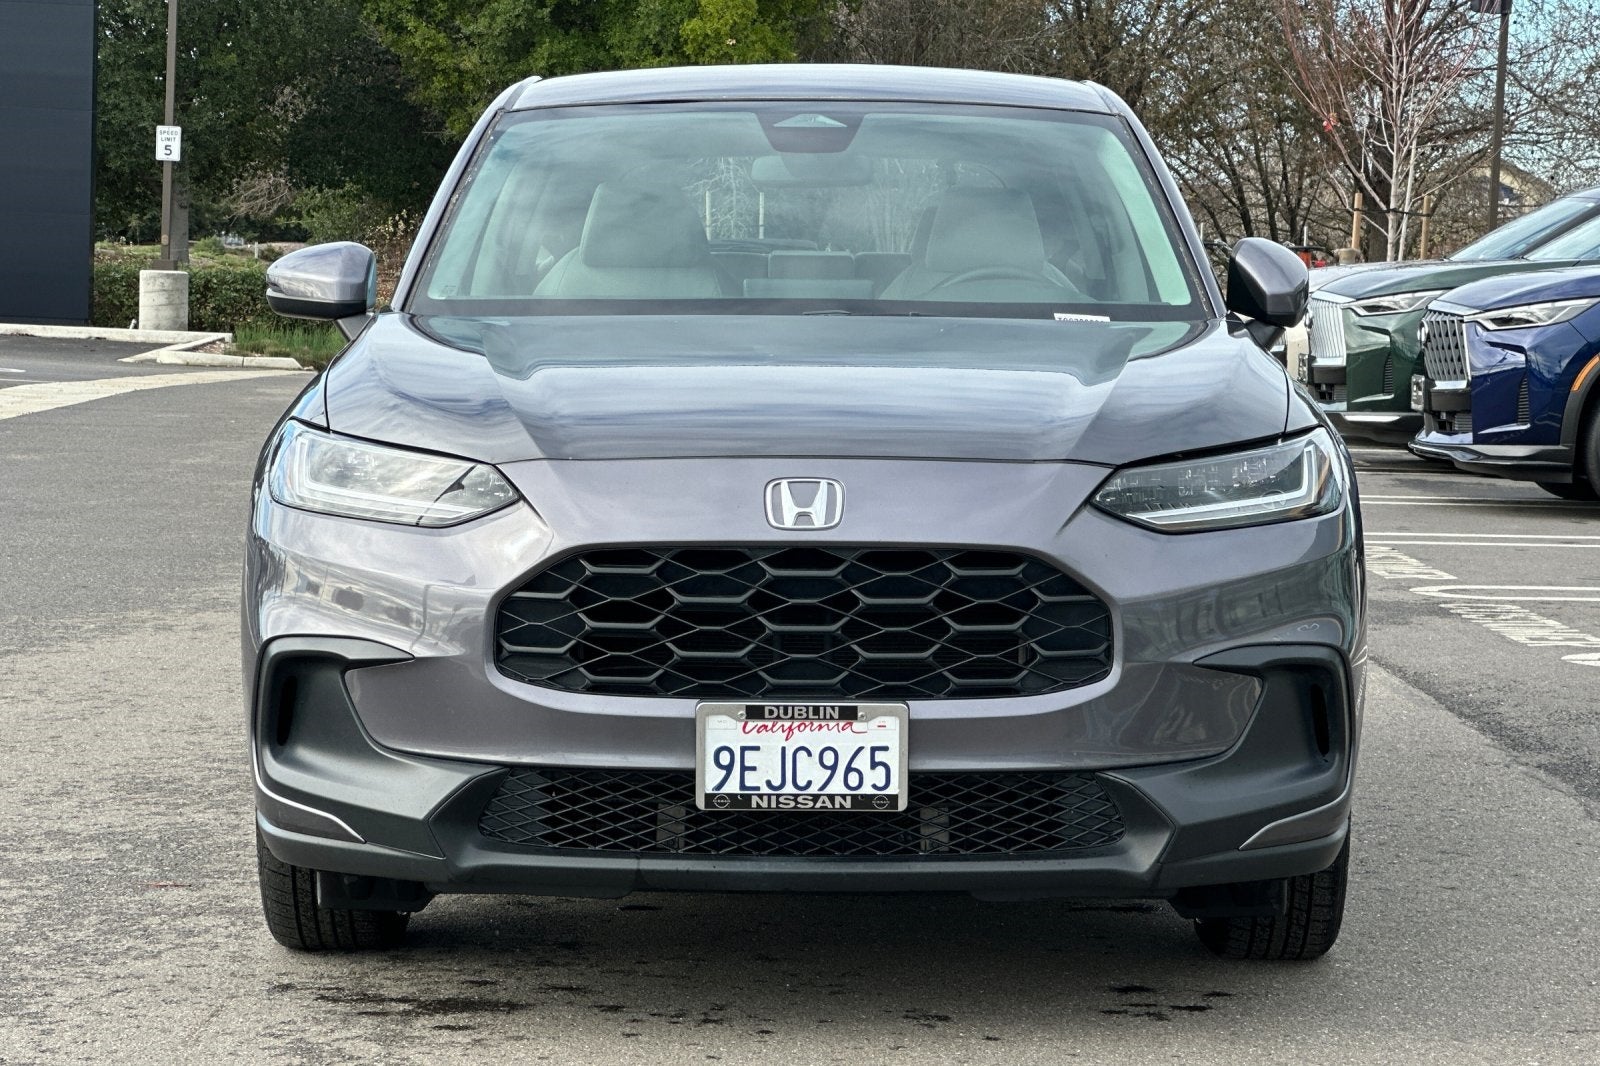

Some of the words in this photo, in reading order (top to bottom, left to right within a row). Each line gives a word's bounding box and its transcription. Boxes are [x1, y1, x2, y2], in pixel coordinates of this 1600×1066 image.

[164, 144, 173, 156] 5
[763, 706, 839, 718] DUBLIN
[742, 720, 868, 741] California
[712, 745, 891, 792] 9EJC965
[751, 795, 851, 808] NISSAN
